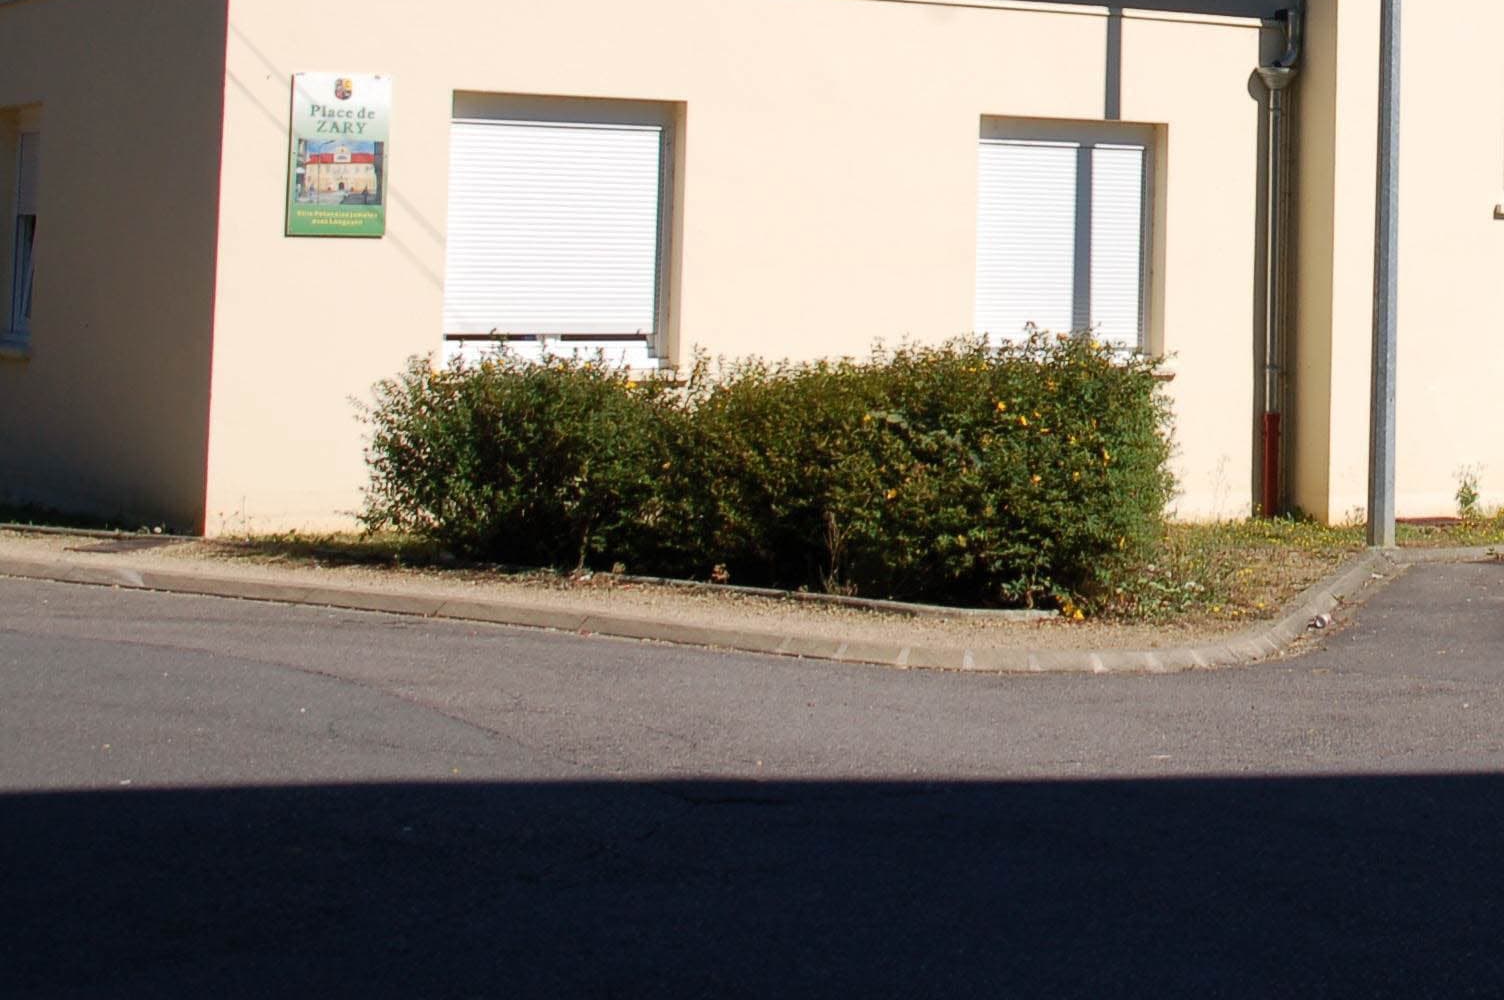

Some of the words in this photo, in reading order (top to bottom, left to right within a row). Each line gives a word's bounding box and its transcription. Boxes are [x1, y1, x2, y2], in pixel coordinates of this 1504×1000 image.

[310, 104, 353, 119] Place
[357, 107, 376, 120] de
[316, 120, 368, 135] ZARY
